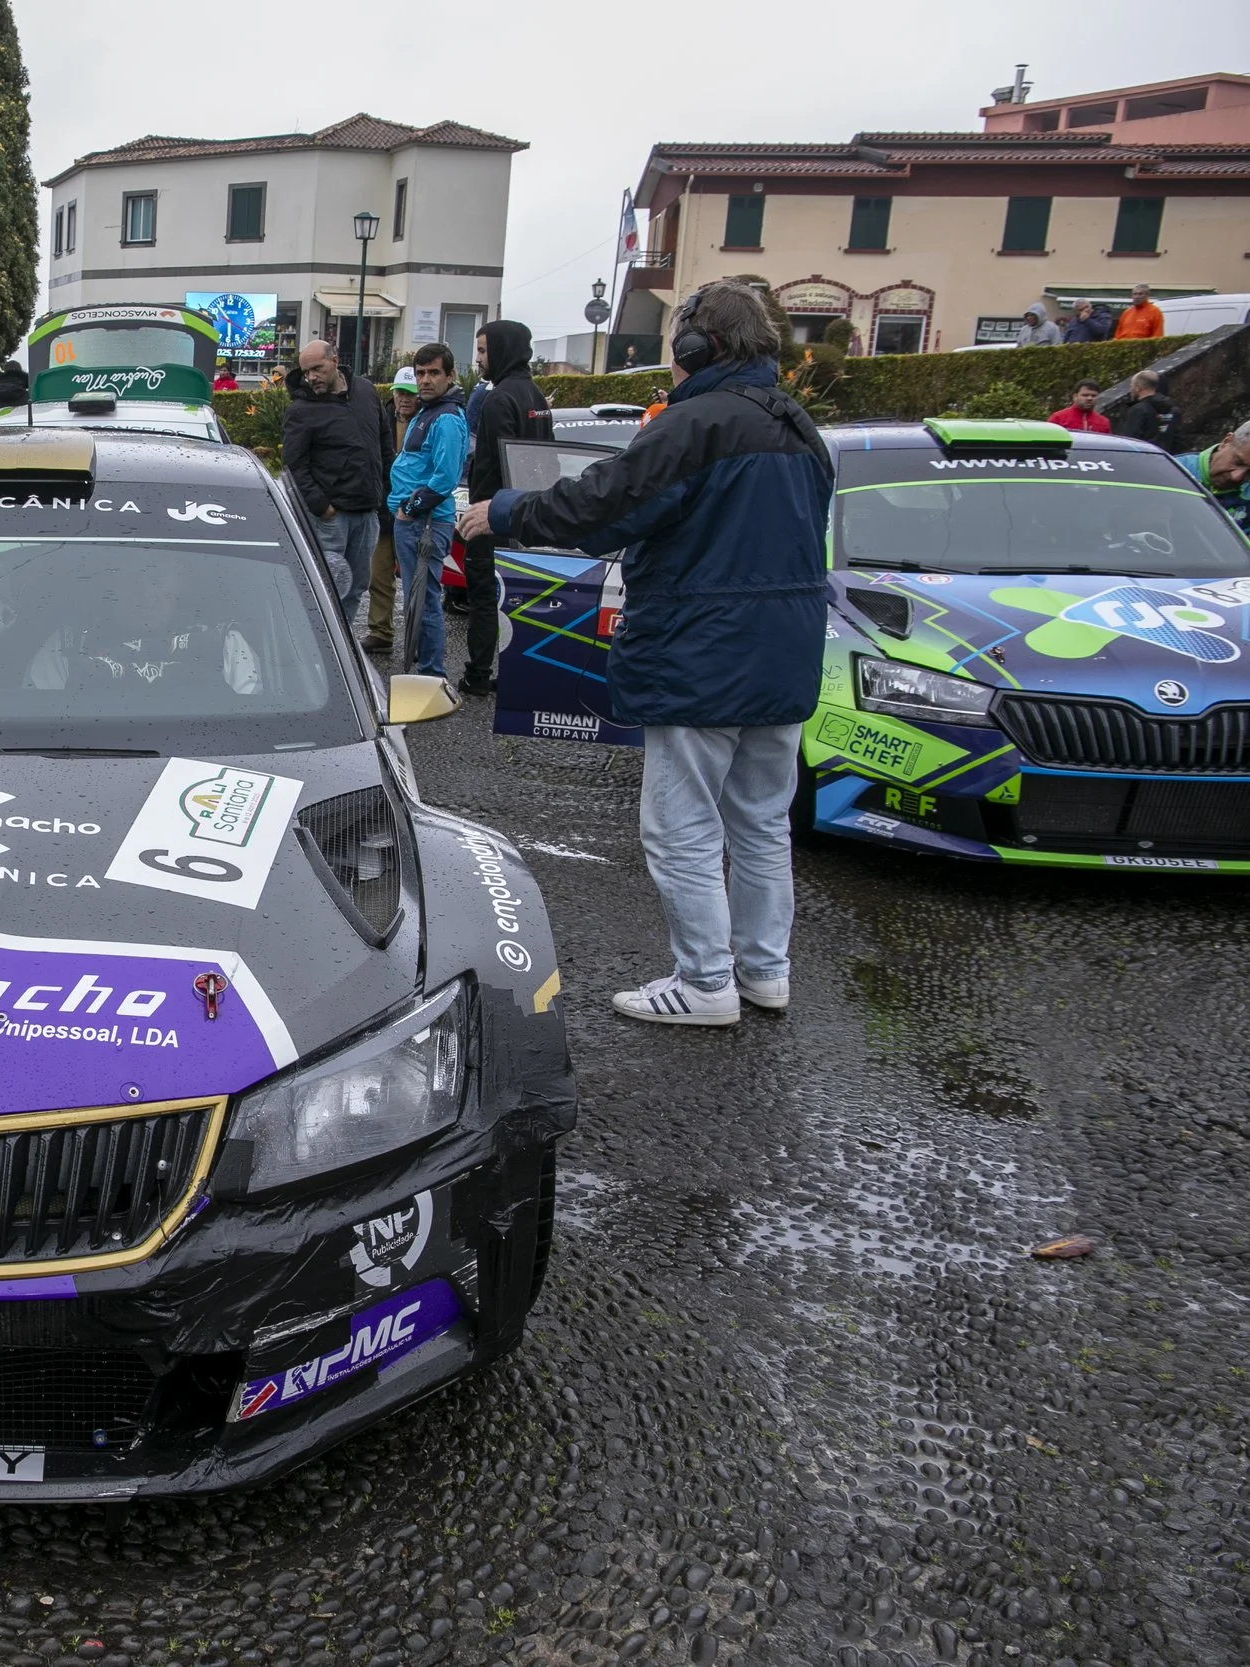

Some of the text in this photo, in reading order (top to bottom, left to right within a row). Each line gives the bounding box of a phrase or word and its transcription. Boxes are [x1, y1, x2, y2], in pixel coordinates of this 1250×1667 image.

[71, 310, 157, 320] MVASCONCELOS
[54, 340, 77, 365] 10
[71, 366, 166, 394] Quebra Mar
[929, 457, 1115, 472] www.rjp.pt
[532, 711, 600, 731] TENNANT
[533, 726, 600, 741] COMPANY
[853, 724, 912, 755] SMART
[849, 740, 905, 769] CHEF
[191, 783, 228, 819] RALI
[213, 779, 256, 832] Santana
[138, 848, 244, 883] 6
[130, 1026, 180, 1048] LDA
[371, 1231, 415, 1259] Publicidade
